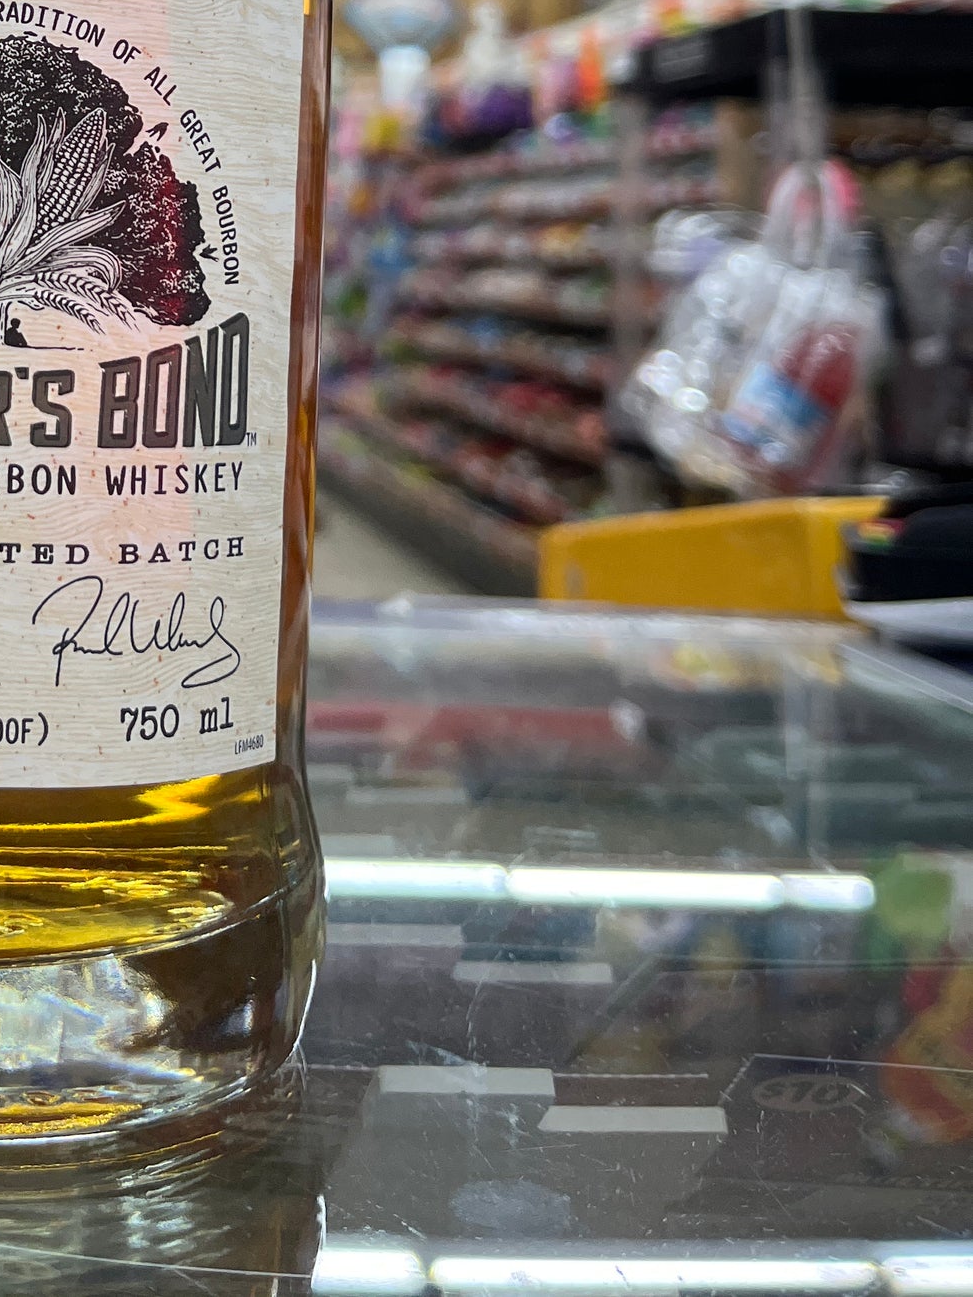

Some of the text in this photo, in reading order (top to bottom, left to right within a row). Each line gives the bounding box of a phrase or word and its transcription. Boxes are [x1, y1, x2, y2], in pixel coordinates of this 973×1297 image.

[112, 39, 141, 64] OF
[144, 66, 177, 106] ALL
[180, 108, 221, 173] GREAT
[212, 185, 239, 285] BOURBON
[97, 311, 250, 450] BOND
[105, 460, 244, 496] WHISKEY
[118, 535, 245, 564] BATCH
[120, 703, 180, 742] 750
[199, 696, 234, 735] ml
